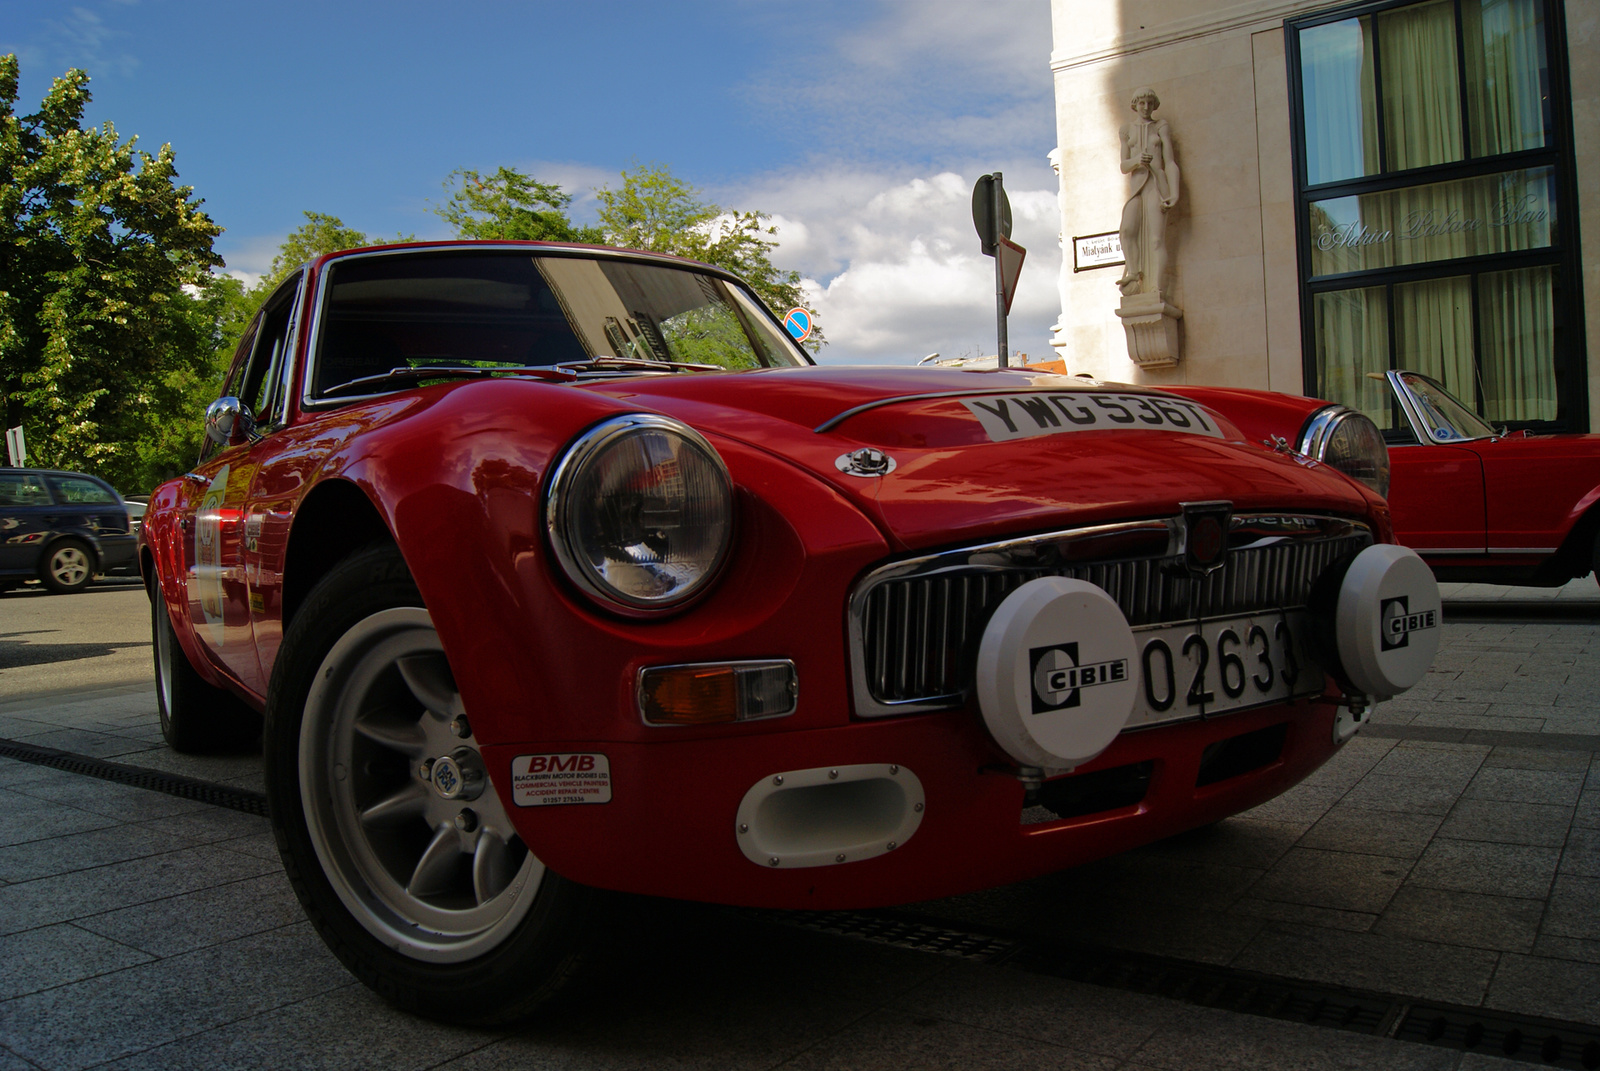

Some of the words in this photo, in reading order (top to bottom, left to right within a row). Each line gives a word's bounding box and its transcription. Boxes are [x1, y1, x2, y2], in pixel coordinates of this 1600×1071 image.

[1317, 220, 1393, 252] Adria
[1397, 208, 1483, 241] Palace
[1488, 194, 1548, 229] Bar
[972, 395, 1096, 433] YWG
[1088, 395, 1211, 432] 536T
[528, 755, 595, 773] BMB
[514, 774, 551, 782] BLACKBURN
[515, 781, 557, 790] COMMERCIAL
